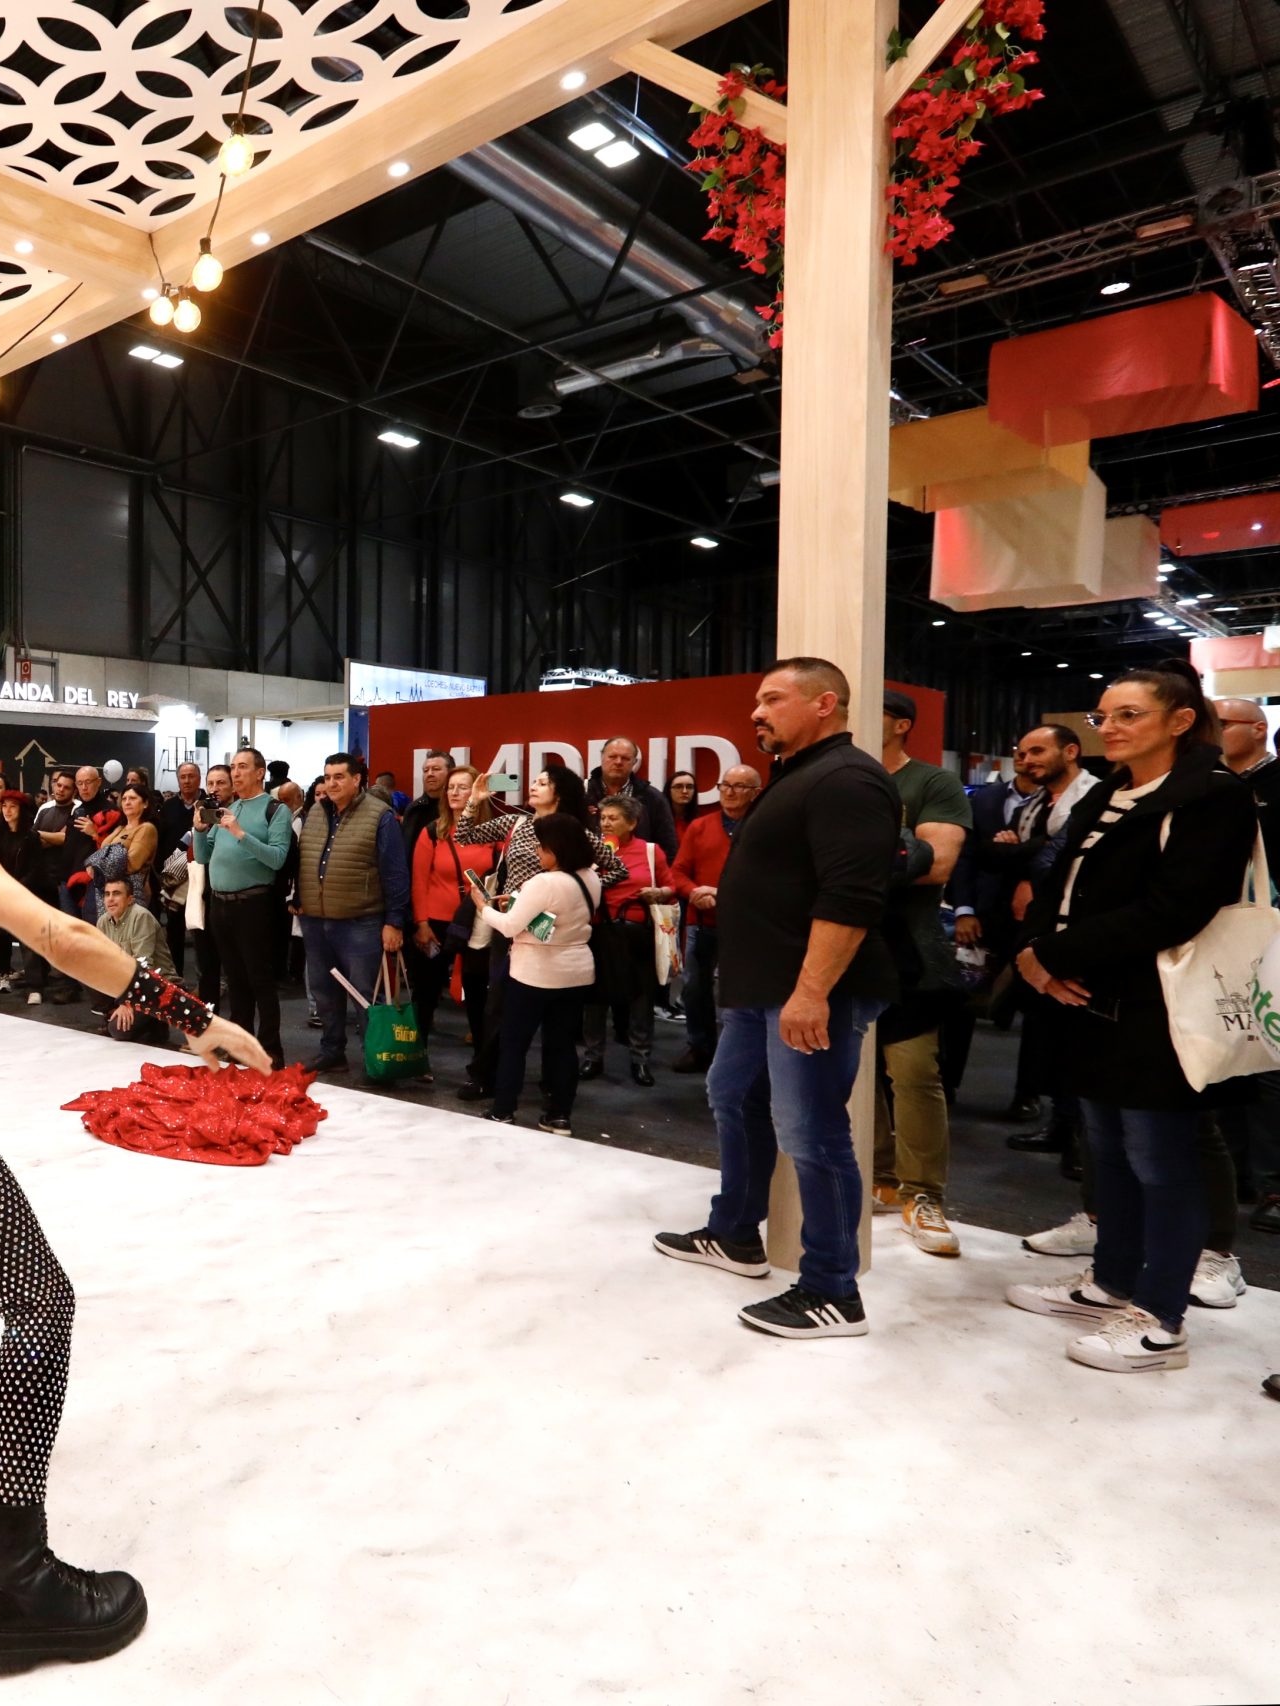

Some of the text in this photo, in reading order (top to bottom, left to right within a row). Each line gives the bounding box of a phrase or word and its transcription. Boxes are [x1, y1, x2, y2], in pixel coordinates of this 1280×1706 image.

[64, 685, 98, 706] DEL
[107, 689, 140, 709] REY
[413, 735, 742, 807] ADID
